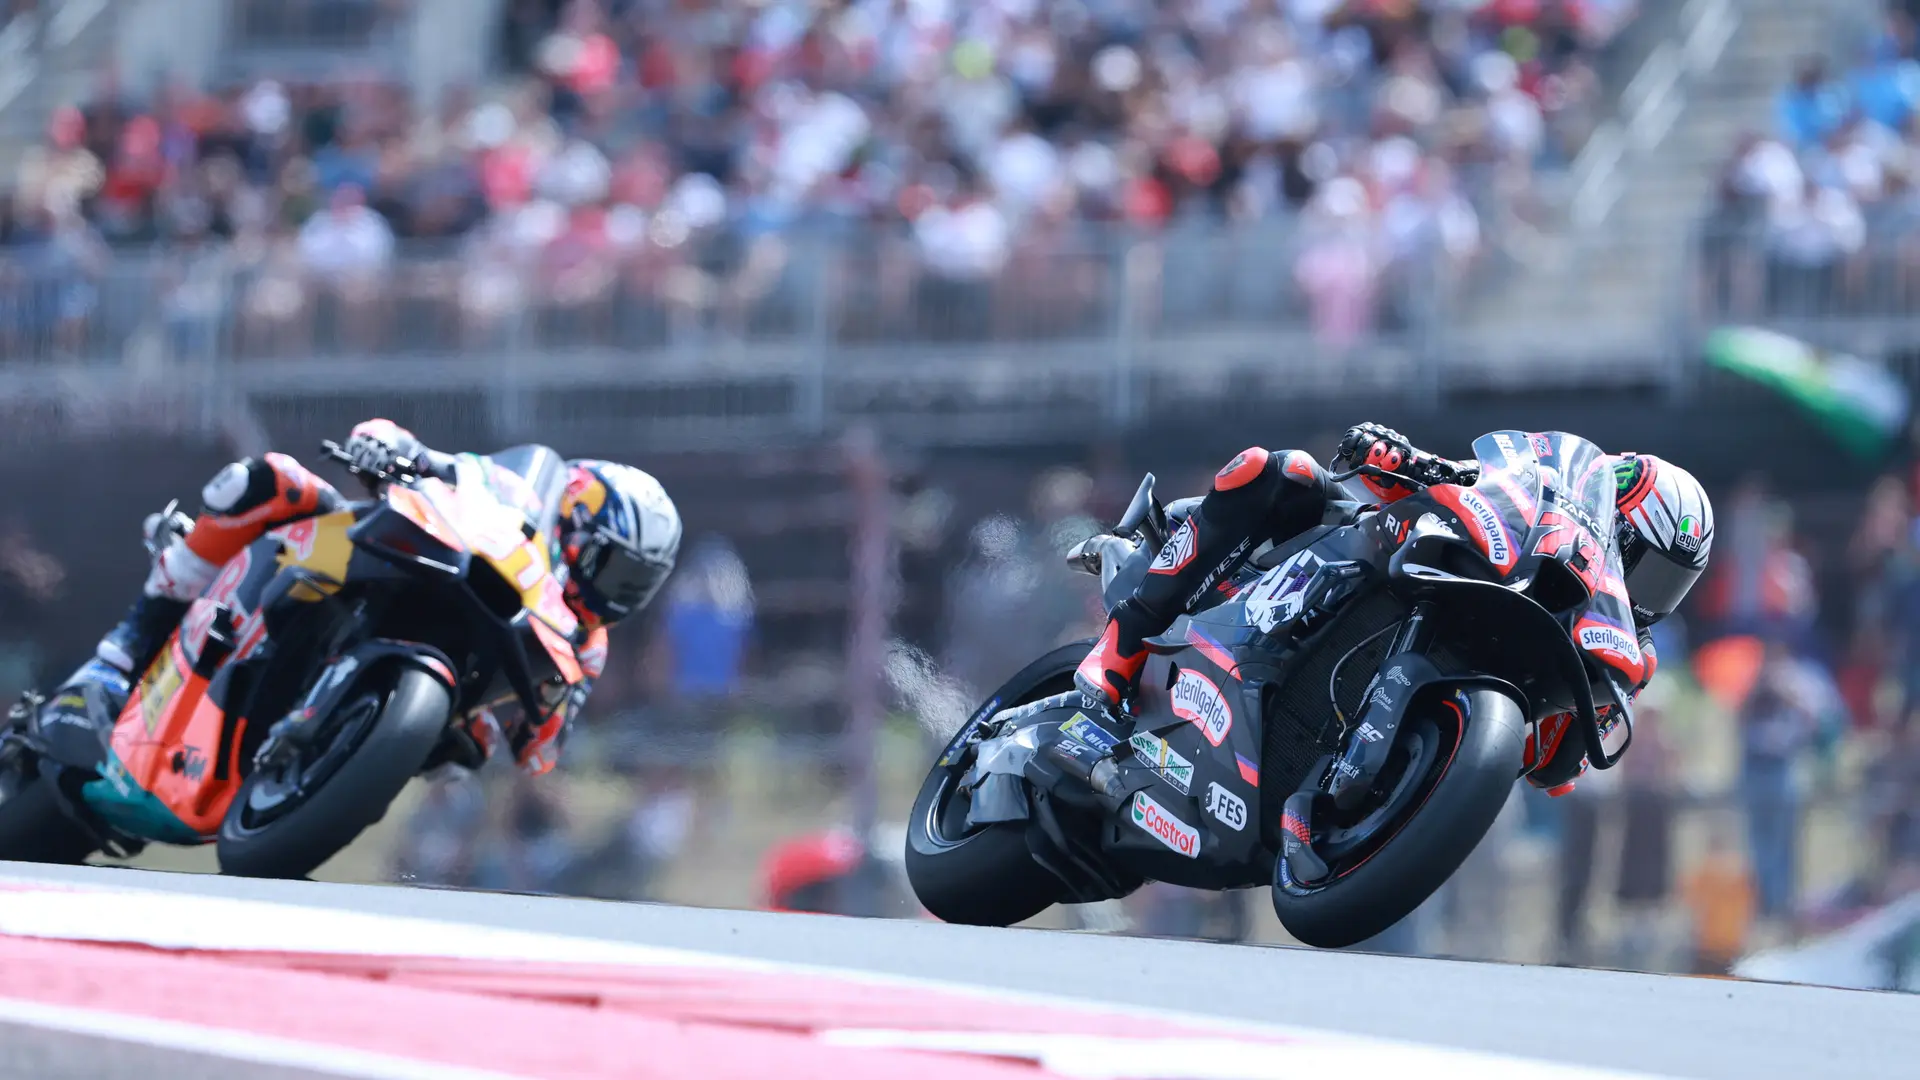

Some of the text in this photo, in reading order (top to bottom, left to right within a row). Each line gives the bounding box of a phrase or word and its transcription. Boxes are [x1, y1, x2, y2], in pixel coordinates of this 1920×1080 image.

[1463, 492, 1505, 562] sterilgarda
[1185, 536, 1251, 611] DAINESE
[1583, 629, 1639, 660] sterilgarda
[1174, 675, 1226, 733] sterilgarda
[1057, 739, 1090, 756] SC
[1166, 754, 1190, 781] Power
[1145, 805, 1196, 855] Castrol
[1217, 793, 1243, 826] FES
